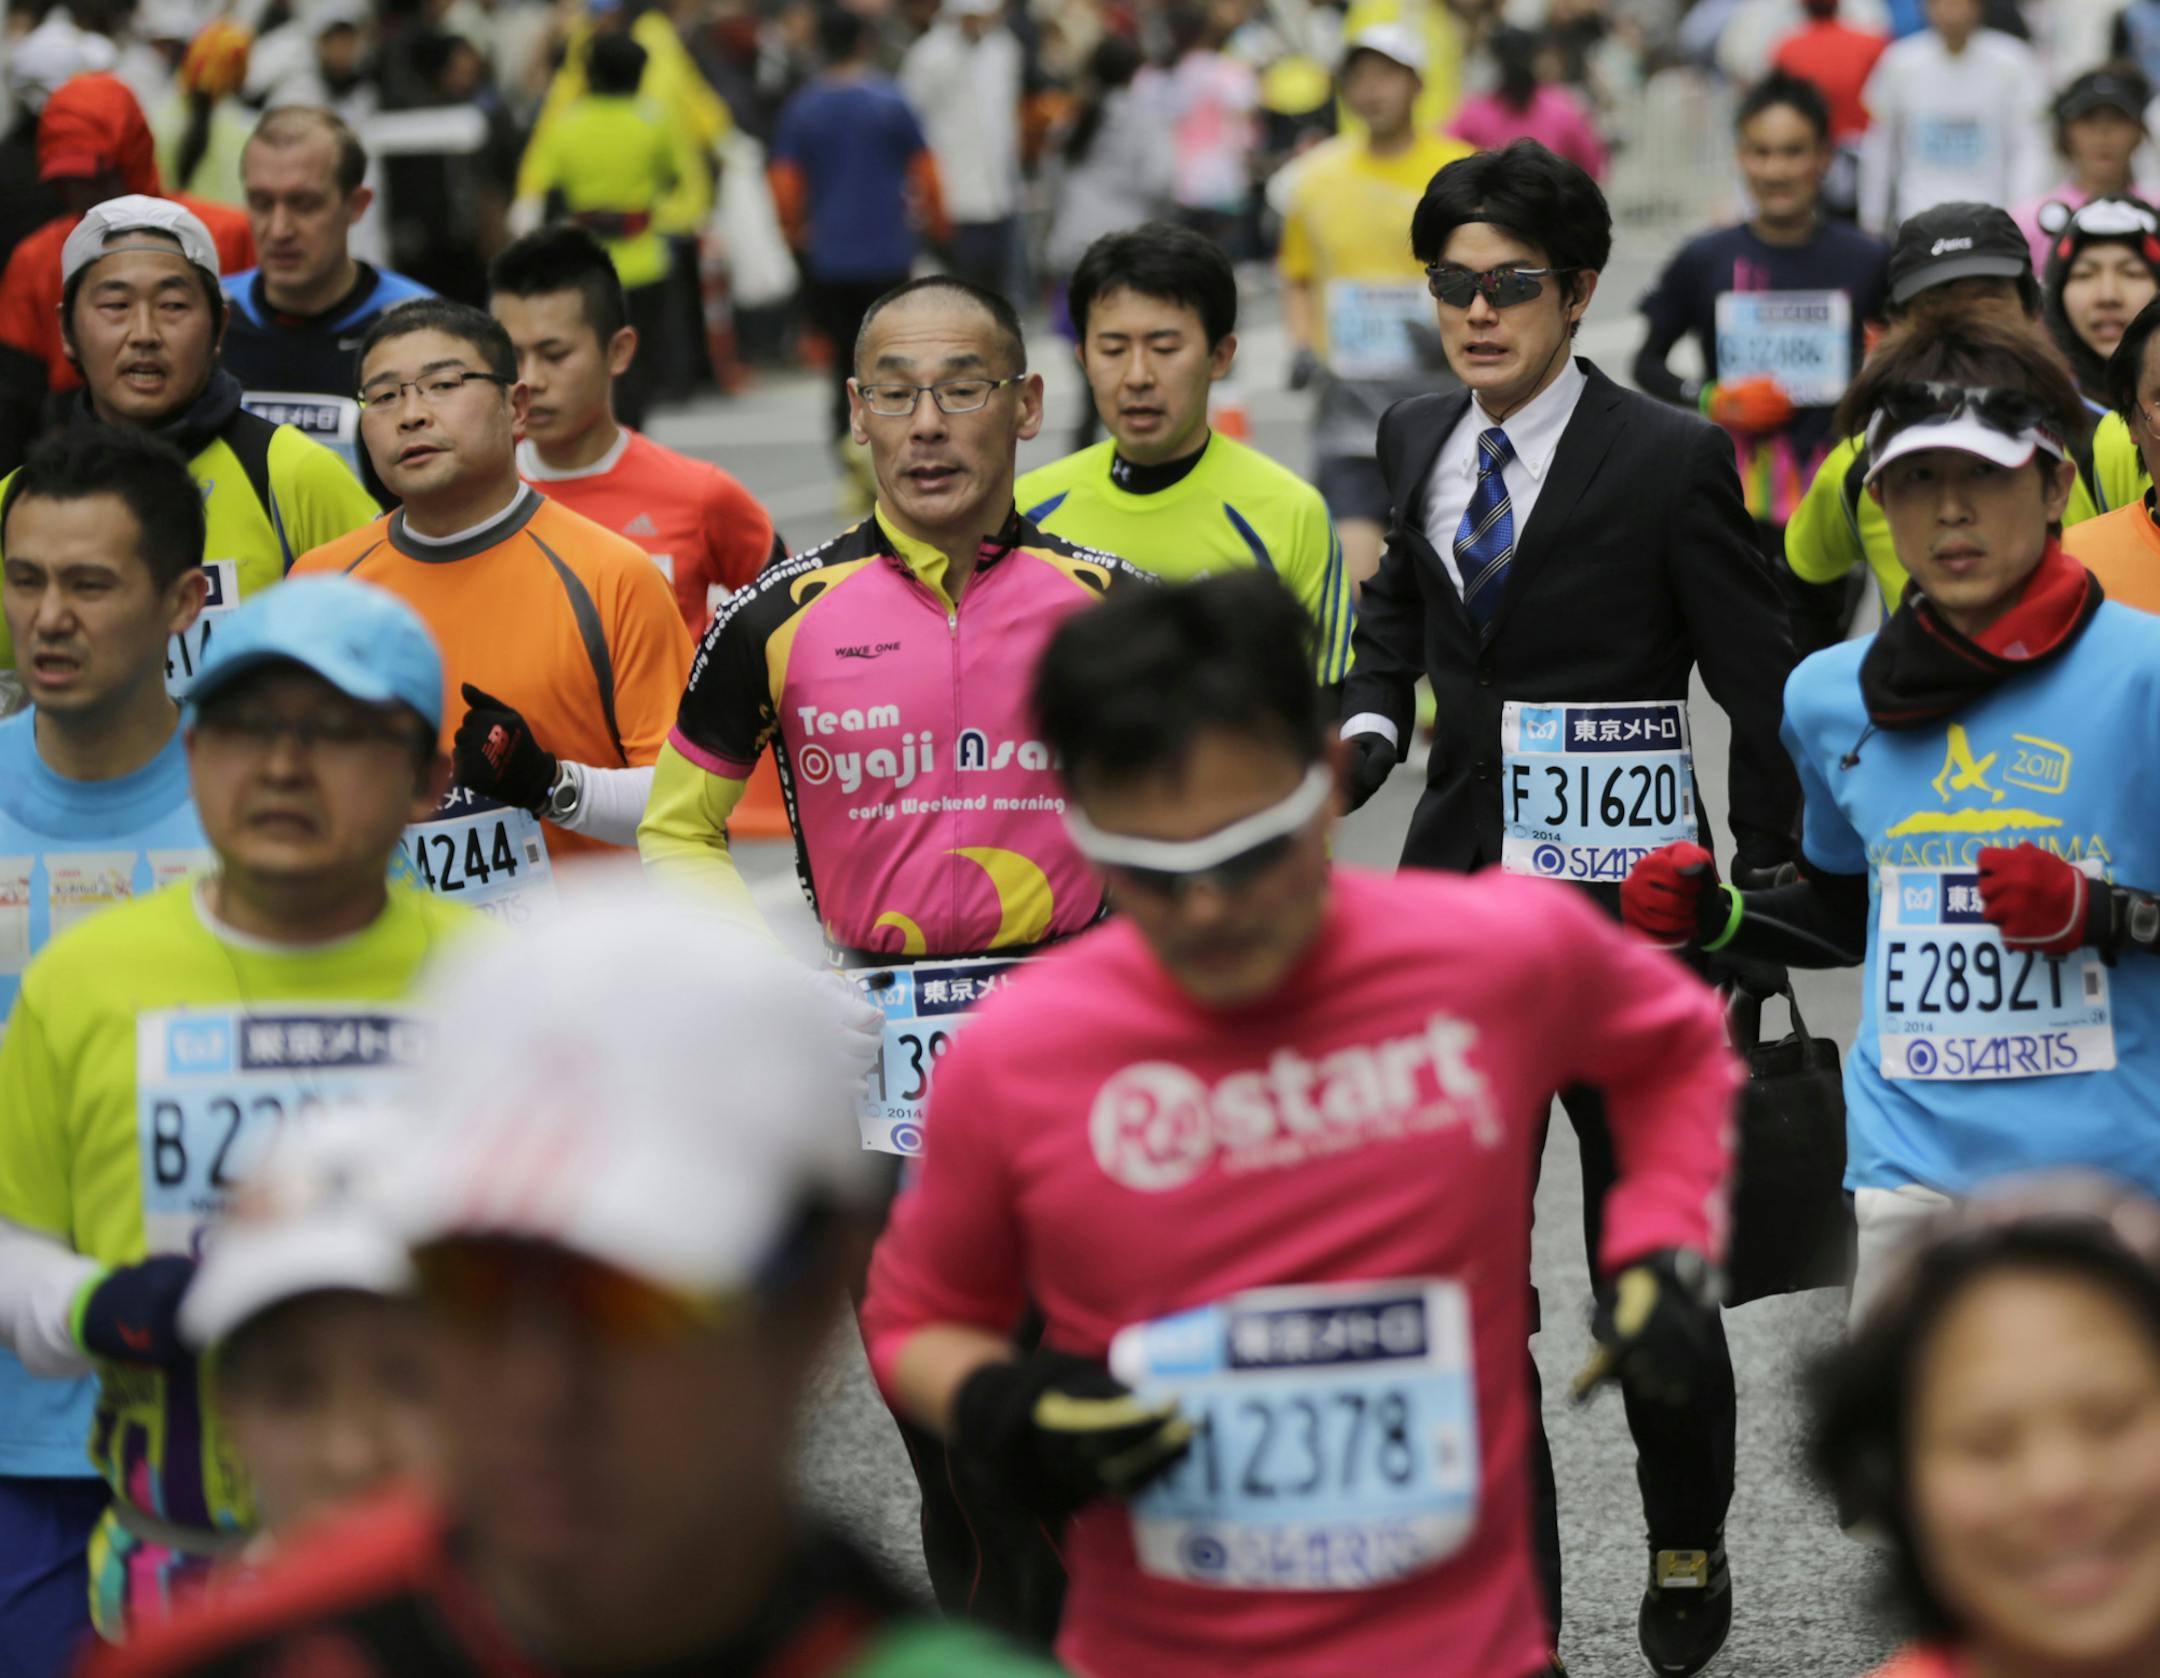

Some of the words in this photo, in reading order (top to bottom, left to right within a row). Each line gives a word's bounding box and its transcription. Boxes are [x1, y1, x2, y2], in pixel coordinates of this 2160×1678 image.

[1072, 551, 1117, 569] early
[688, 653, 709, 692] early
[760, 557, 824, 592] morning
[835, 646, 870, 657] WAVE
[875, 641, 901, 652] ONE
[798, 704, 900, 736] Team
[1573, 718, 1678, 742] 東京メトロ
[848, 802, 895, 821] early
[901, 795, 987, 816] Weekend
[993, 794, 1066, 814] morning
[1513, 764, 1530, 823] F
[1544, 764, 1677, 827] 31620
[1532, 830, 1562, 842] 2014
[401, 820, 518, 892] 4244
[1886, 943, 1906, 1013] E
[1904, 1020, 1933, 1033] 2014
[888, 1107, 923, 1119] 2014
[153, 1099, 187, 1188] B
